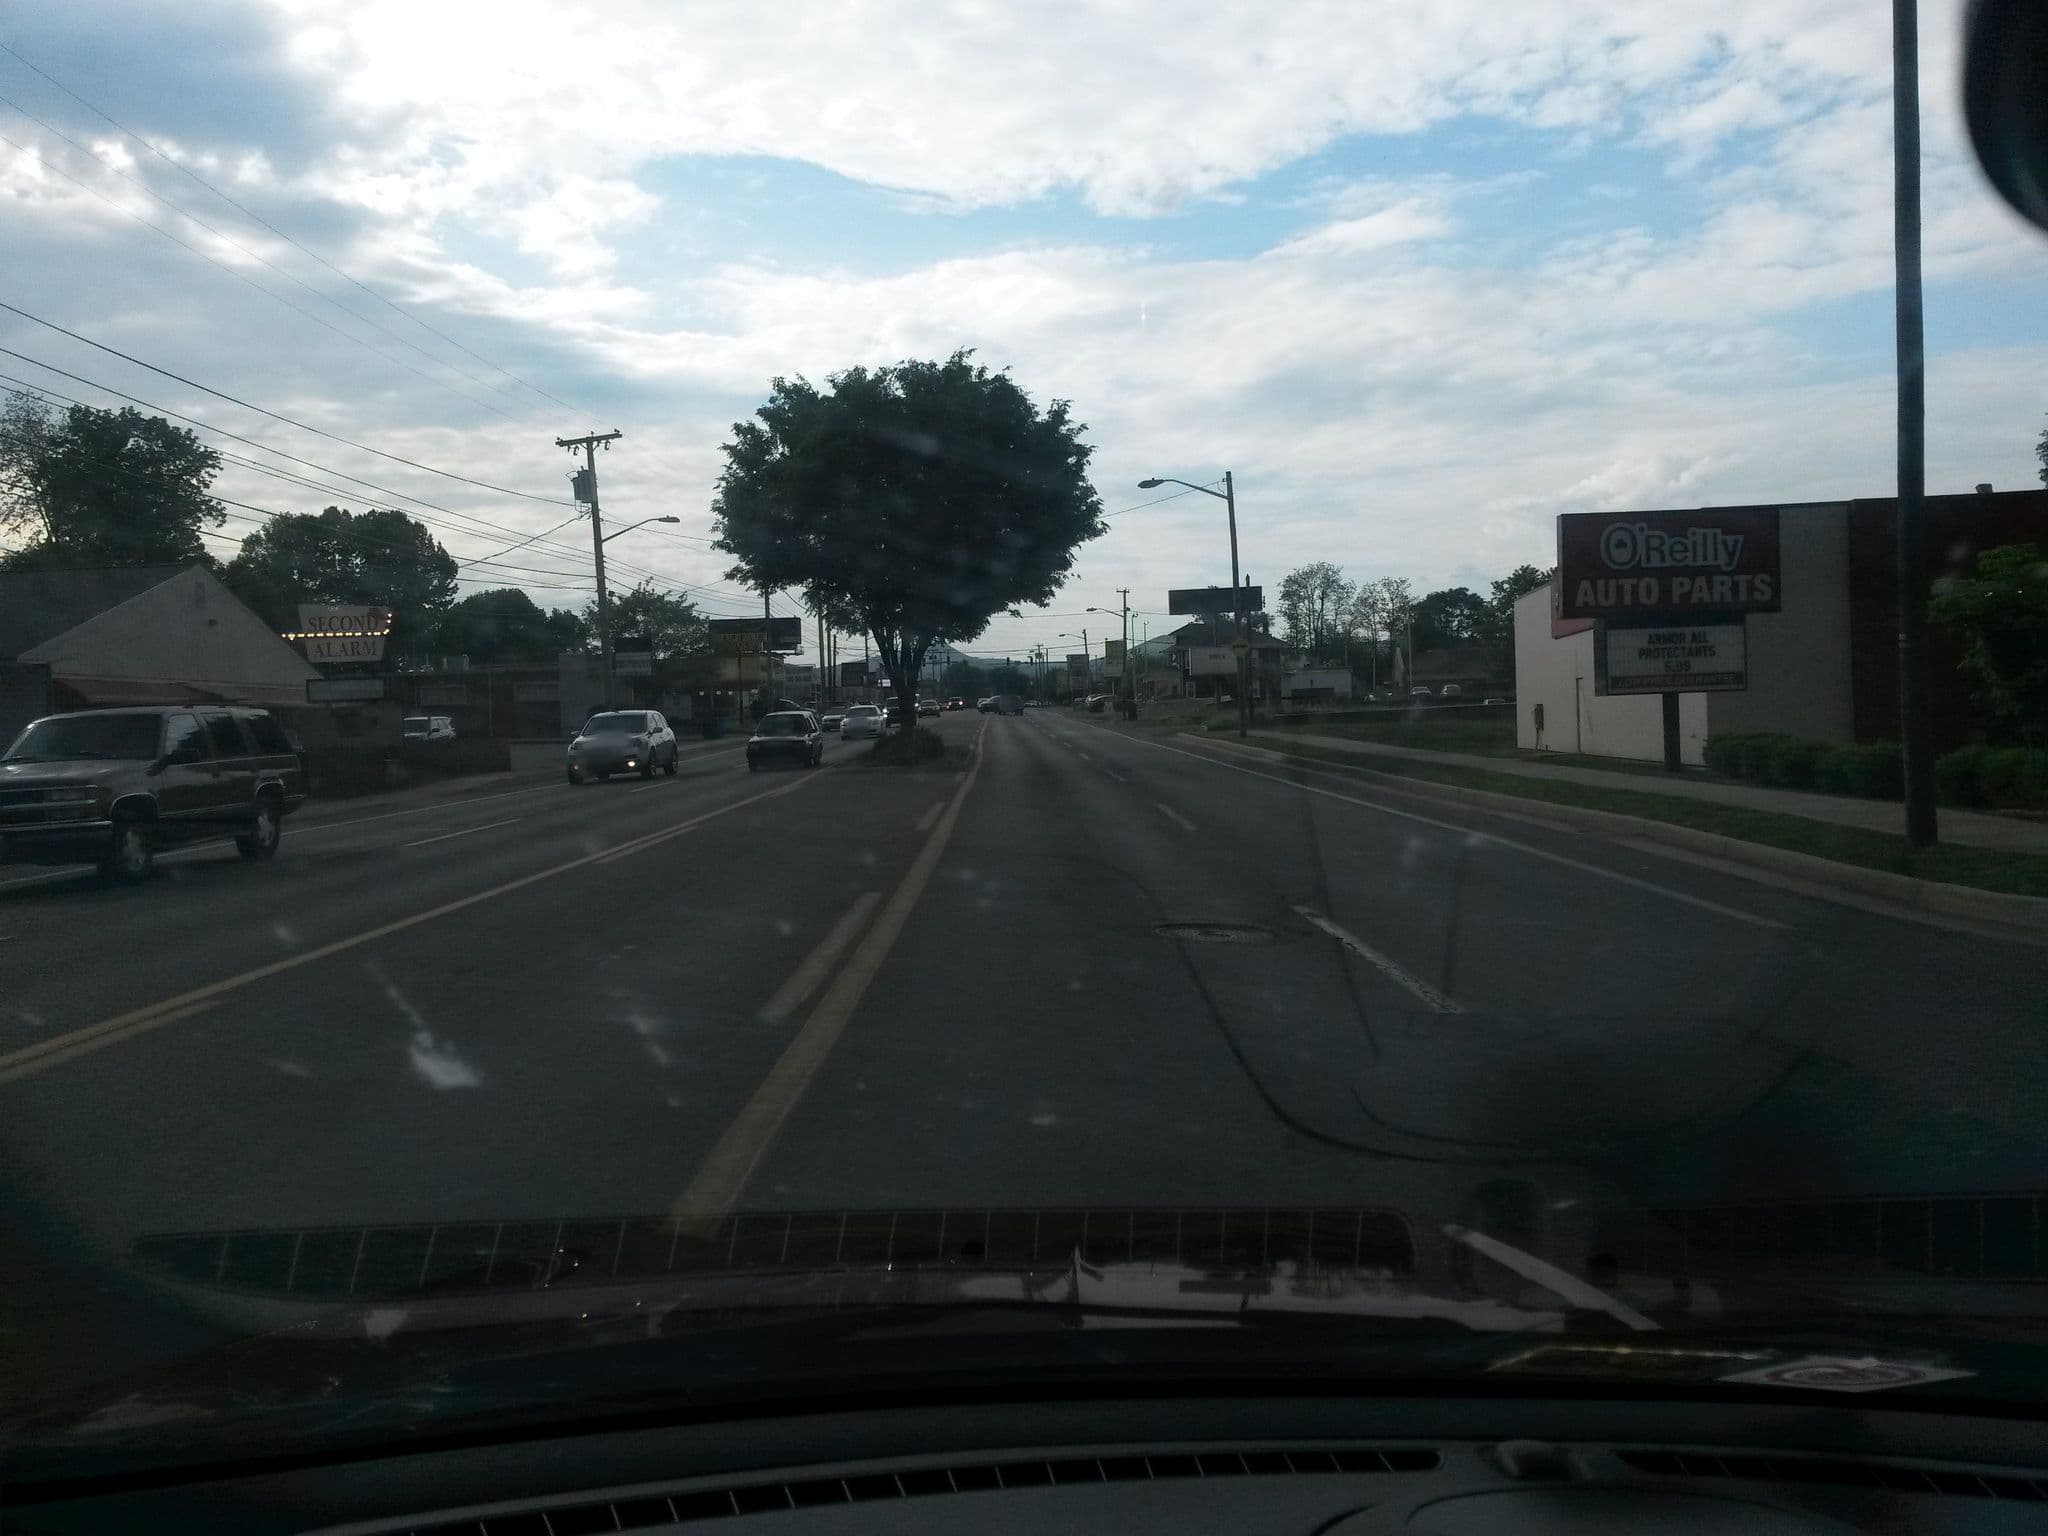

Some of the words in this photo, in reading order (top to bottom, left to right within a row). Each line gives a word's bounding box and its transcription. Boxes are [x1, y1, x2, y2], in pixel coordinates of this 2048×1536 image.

[1600, 523, 1744, 571] O'Reilly
[1576, 578, 1659, 607] AUTO
[1673, 575, 1772, 604] PARTS
[309, 615, 378, 631] SECOND
[1648, 632, 1685, 645] ARMOR
[1690, 631, 1709, 643] ALL
[314, 641, 376, 657] ALARM
[1639, 645, 1716, 659] PROTECTANTS
